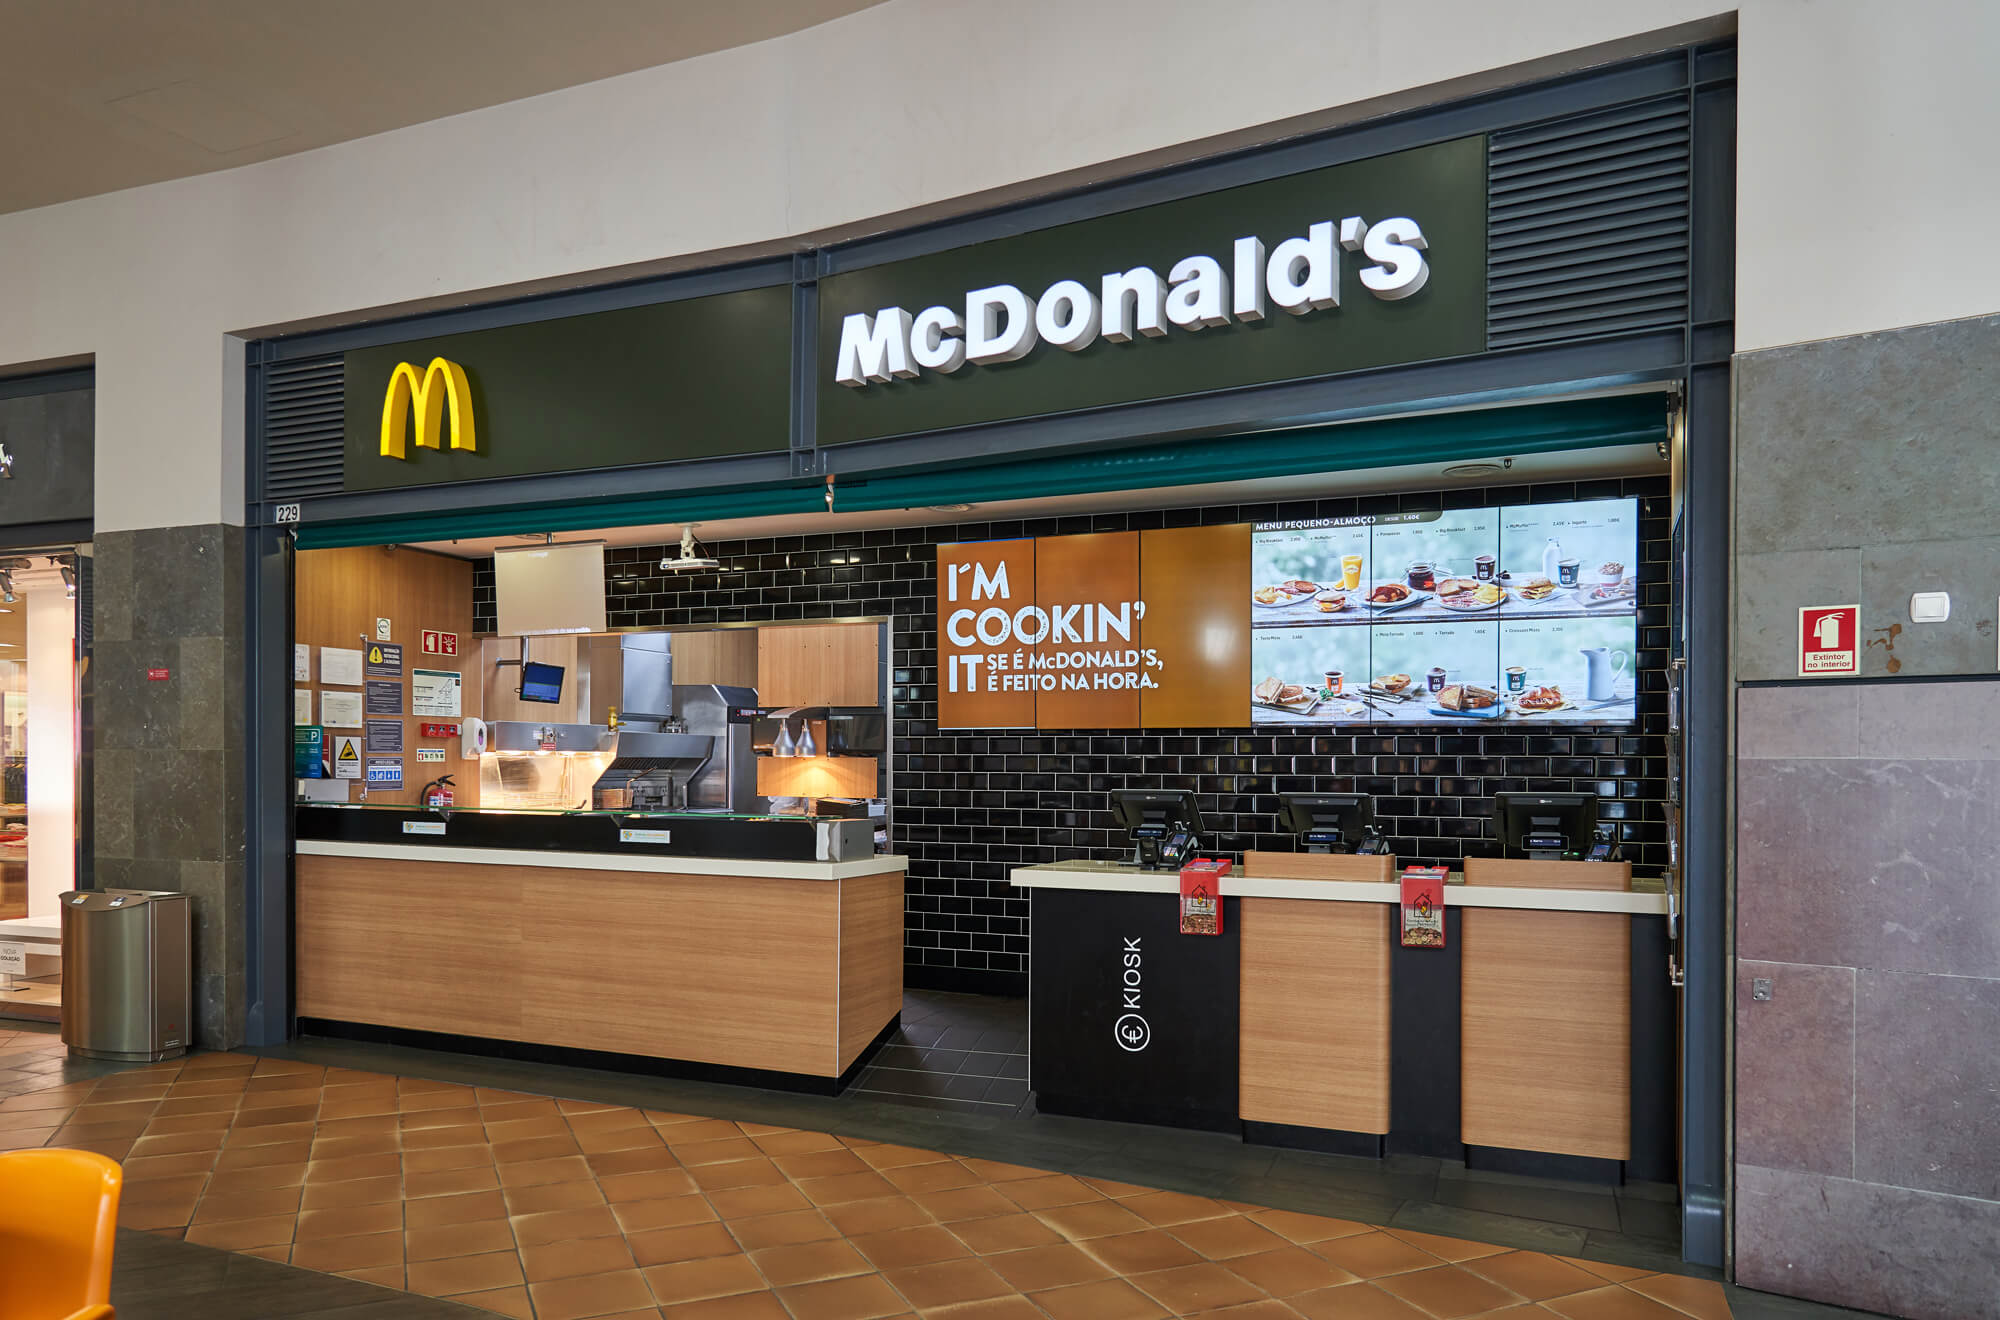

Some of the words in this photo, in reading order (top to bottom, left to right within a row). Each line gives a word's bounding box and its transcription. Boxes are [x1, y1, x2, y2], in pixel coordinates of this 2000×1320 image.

[835, 216, 1430, 388] McDonald's
[278, 506, 298, 522] 229
[1255, 522, 1283, 531] MENU
[1285, 515, 1376, 529] PEQUENO-ALMOÇO
[947, 560, 1010, 601] I'M
[946, 600, 1146, 647] COOKIN'
[948, 654, 984, 693] IT
[986, 653, 1009, 671] SE
[1013, 648, 1024, 670] É
[1028, 648, 1164, 671] McDONALD'S,
[987, 672, 999, 692] É
[1003, 674, 1057, 692] FEITO
[1061, 673, 1090, 691] NA
[1093, 672, 1160, 690] HORA.
[1123, 936, 1142, 1009] KIOSK
